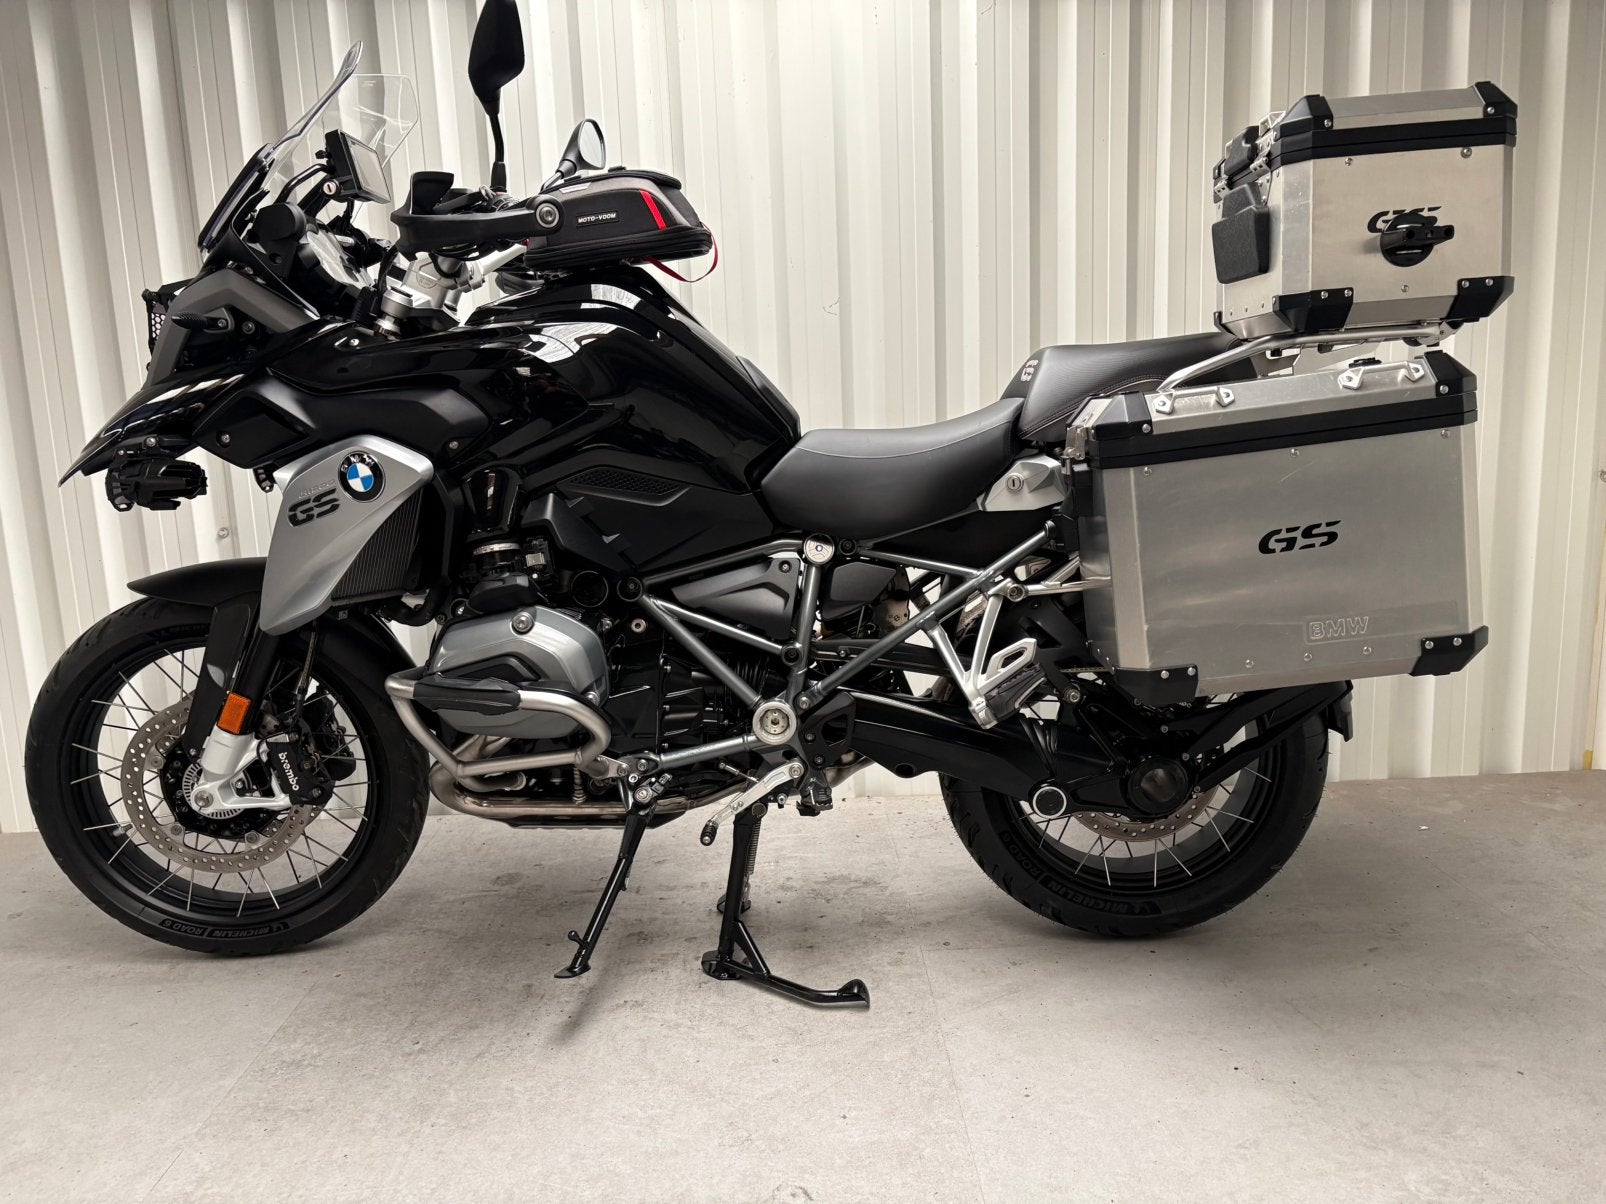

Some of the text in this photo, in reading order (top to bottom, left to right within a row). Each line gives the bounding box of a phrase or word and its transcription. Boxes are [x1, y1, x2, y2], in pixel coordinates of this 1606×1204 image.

[288, 487, 341, 527] GS
[1258, 519, 1342, 554] GS
[1309, 615, 1369, 640] BMW
[278, 751, 300, 792] brembo
[1009, 843, 1042, 877] ROAD
[1047, 877, 1129, 914] MICHELIN
[173, 921, 201, 936] ROAD
[212, 925, 270, 938] MICHELIN
